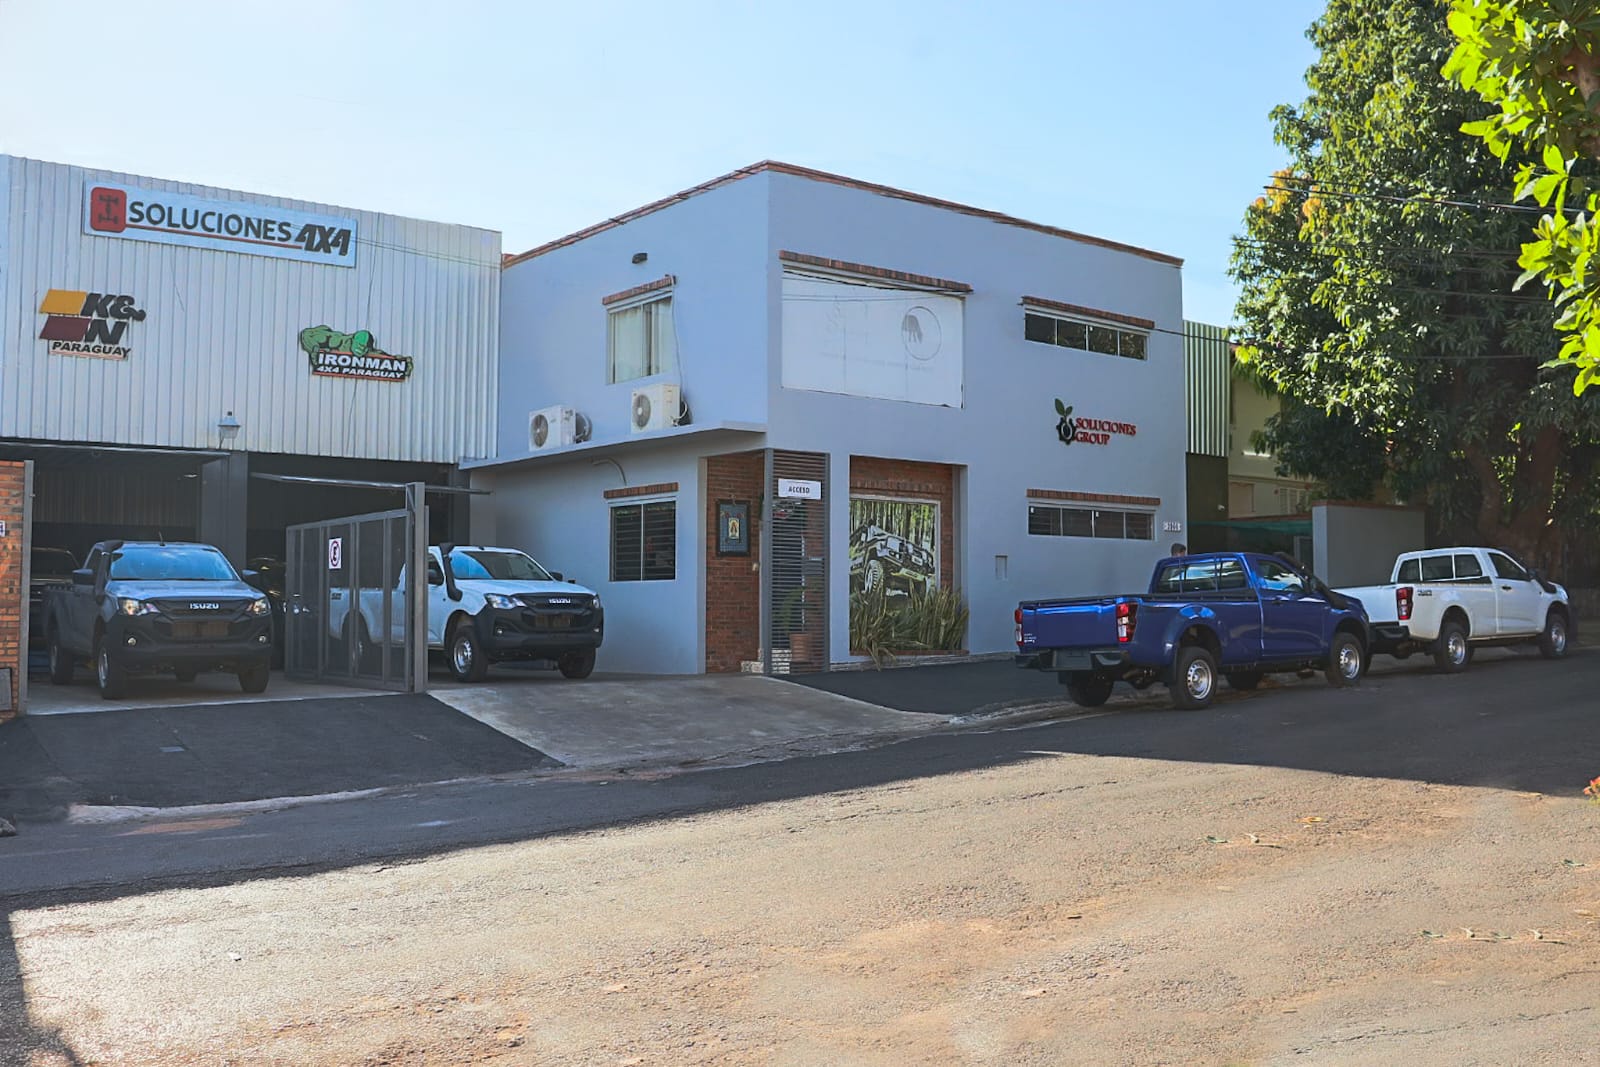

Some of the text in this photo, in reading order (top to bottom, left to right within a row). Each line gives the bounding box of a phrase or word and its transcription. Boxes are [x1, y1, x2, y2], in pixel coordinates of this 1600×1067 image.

[129, 201, 292, 242] SOLUCIONES
[52, 341, 132, 359] PARAGUAY
[318, 353, 406, 371] IRONMAN
[342, 367, 404, 379] PARAGUAY
[1075, 417, 1137, 436] SOLUCIONES
[1075, 431, 1110, 445] GROUP
[189, 602, 220, 610] ISUZU
